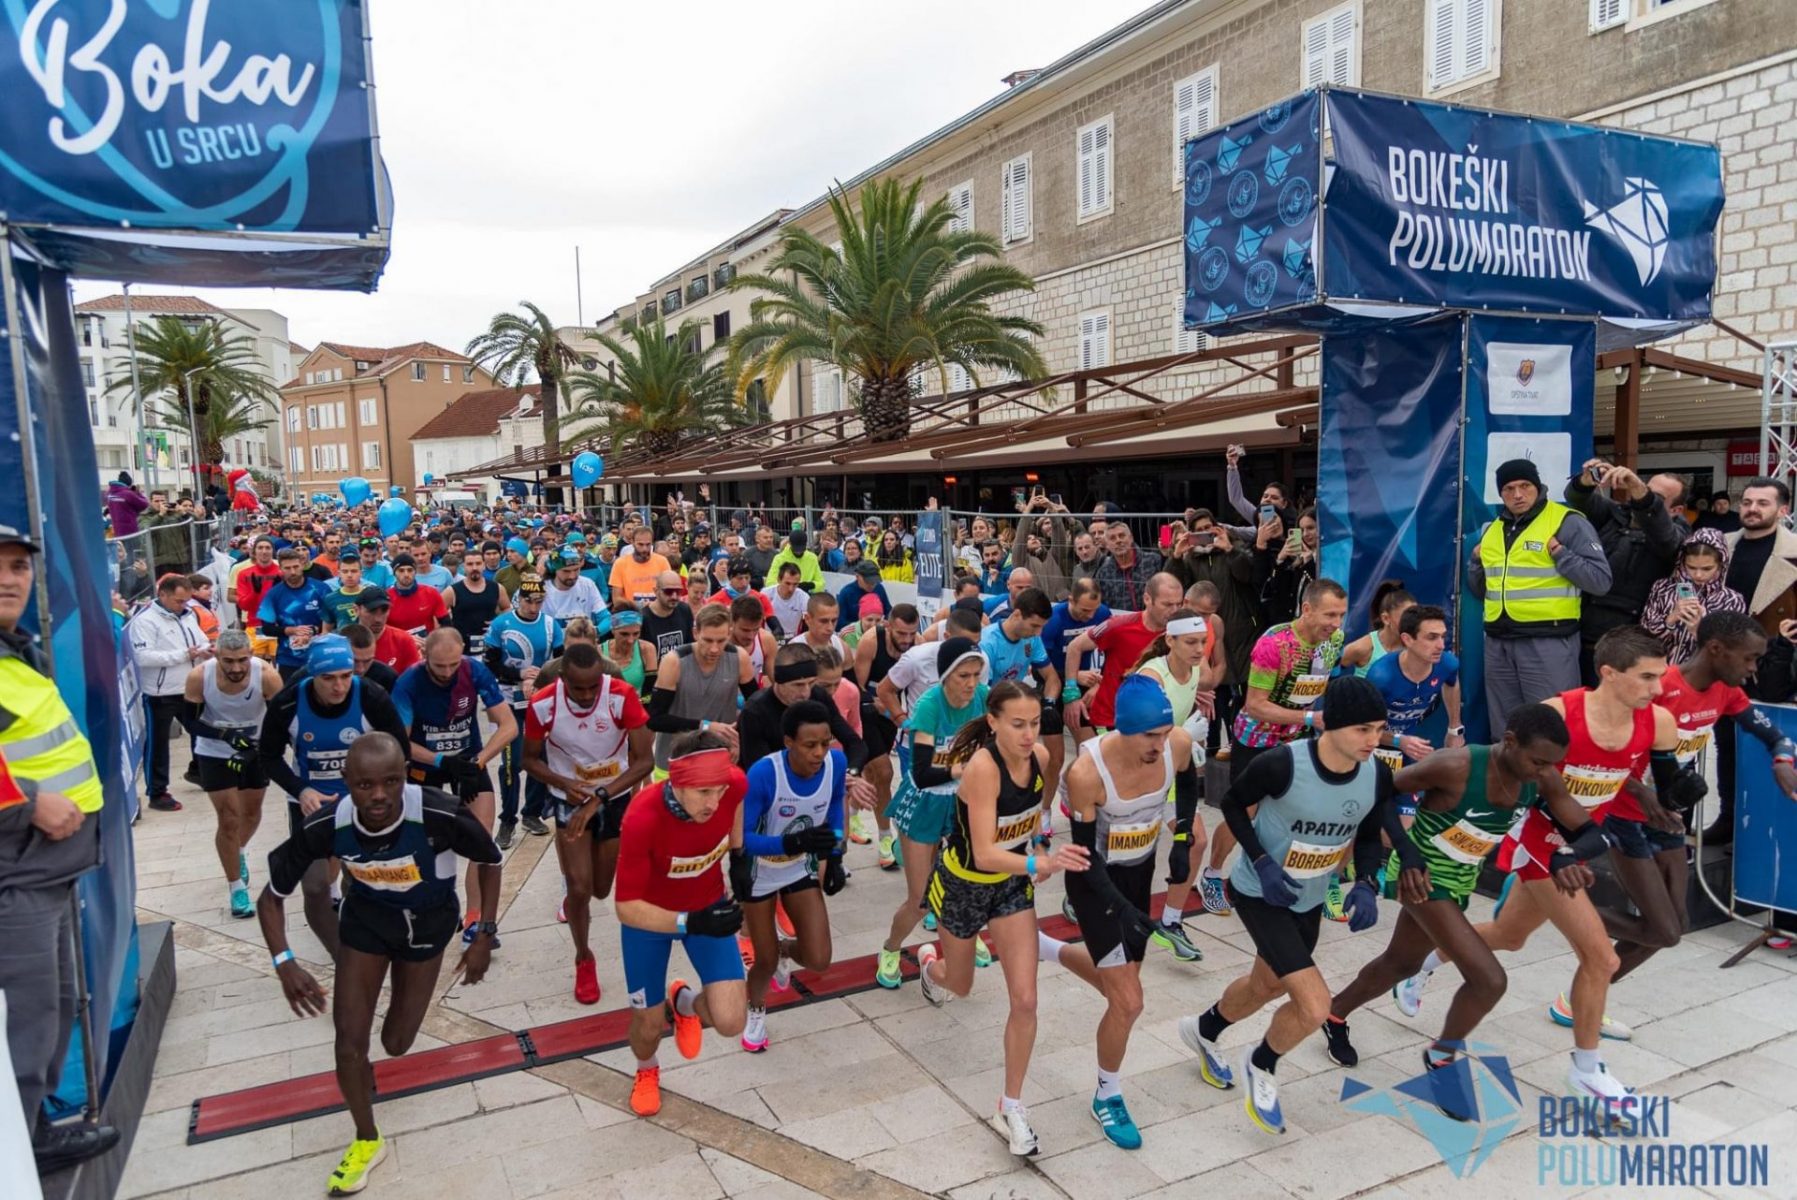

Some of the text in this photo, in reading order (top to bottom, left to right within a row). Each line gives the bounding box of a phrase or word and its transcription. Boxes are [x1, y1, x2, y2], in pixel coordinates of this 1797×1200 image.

[20, 0, 315, 155] Boka
[146, 123, 262, 170] U SRCU
[1388, 143, 1509, 215] BOKEŠKI
[1389, 209, 1592, 282] POLUMARATON
[919, 552, 942, 579] ELITE
[436, 740, 461, 751] 833
[1290, 819, 1357, 837] APATIN
